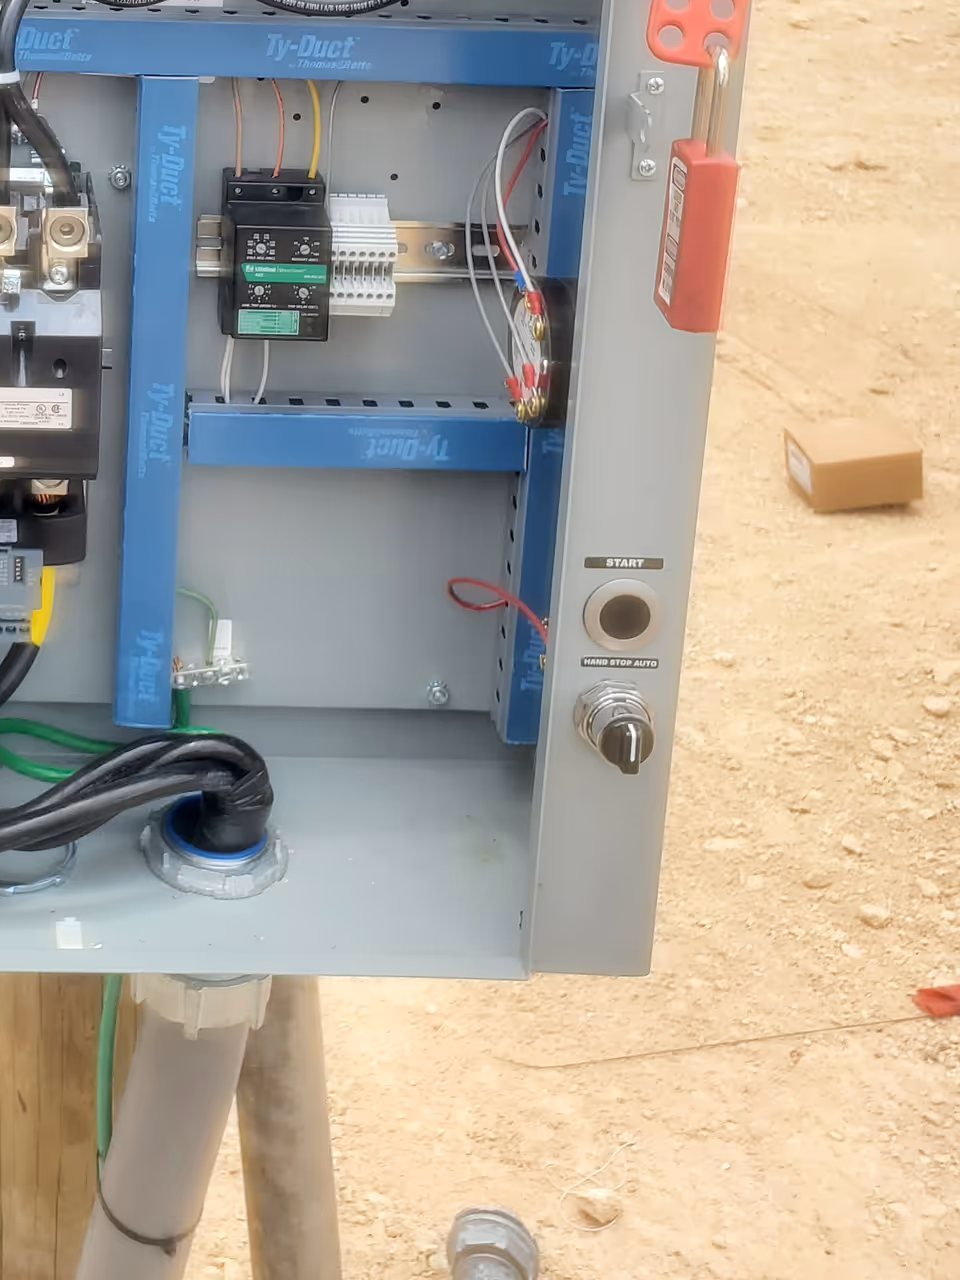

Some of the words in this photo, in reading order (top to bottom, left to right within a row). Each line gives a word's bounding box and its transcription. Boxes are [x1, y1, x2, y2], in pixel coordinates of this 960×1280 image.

[304, 2, 319, 11] AWM
[335, 3, 350, 11] 105C
[16, 26, 73, 50] Duct
[266, 33, 356, 61] Ty-Duct
[549, 42, 598, 70] Ty-D
[158, 125, 186, 206] Ty-Duct
[147, 382, 175, 464] Ty-Duct
[606, 558, 645, 568] START
[583, 658, 608, 666] HAND
[609, 658, 632, 666] STOP
[633, 660, 658, 668] AUTO
